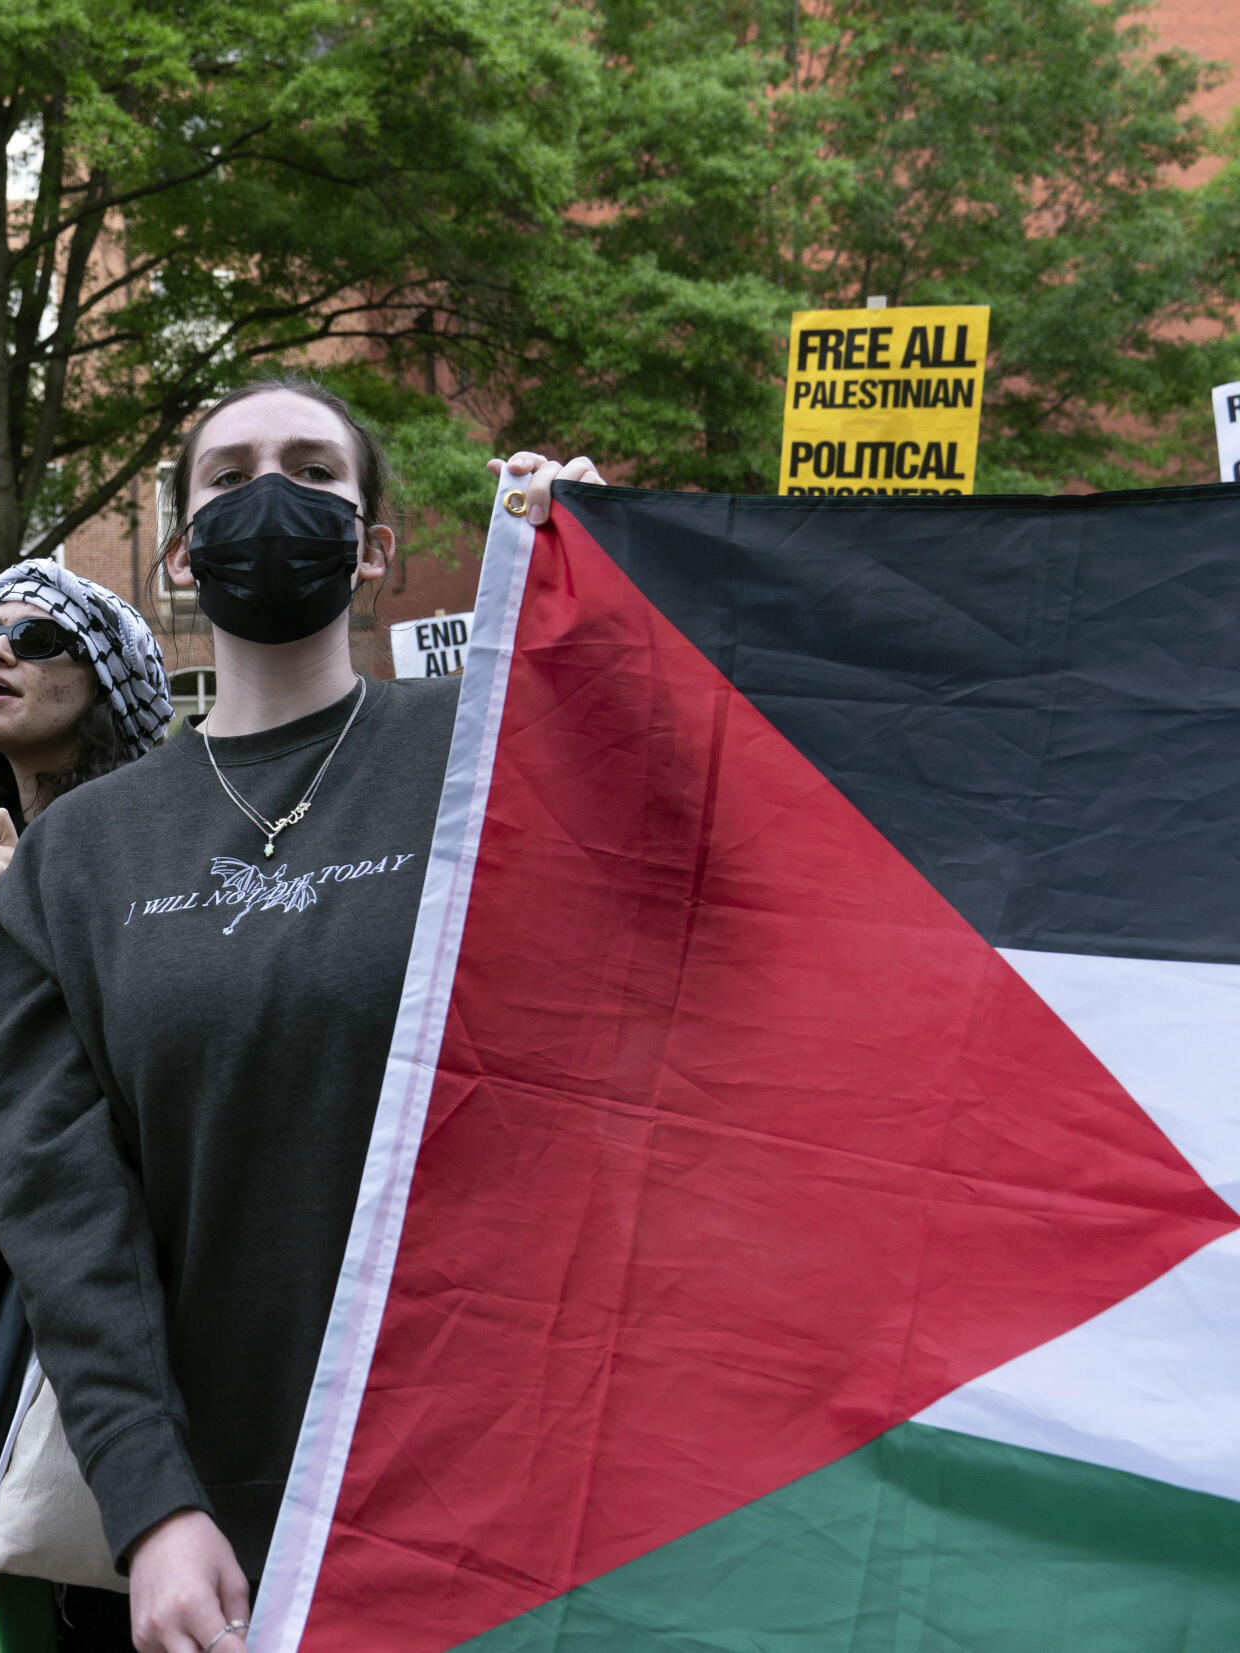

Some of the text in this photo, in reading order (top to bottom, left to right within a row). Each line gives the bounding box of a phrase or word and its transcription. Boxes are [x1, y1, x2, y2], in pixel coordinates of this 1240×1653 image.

[797, 325, 977, 371] FREE ALL
[792, 378, 975, 409] PALESTINIAN
[789, 441, 965, 480] POLITICAL
[416, 620, 468, 651] END
[142, 892, 200, 915] WILL
[202, 886, 267, 907] NOT
[317, 853, 416, 884] TODAY
